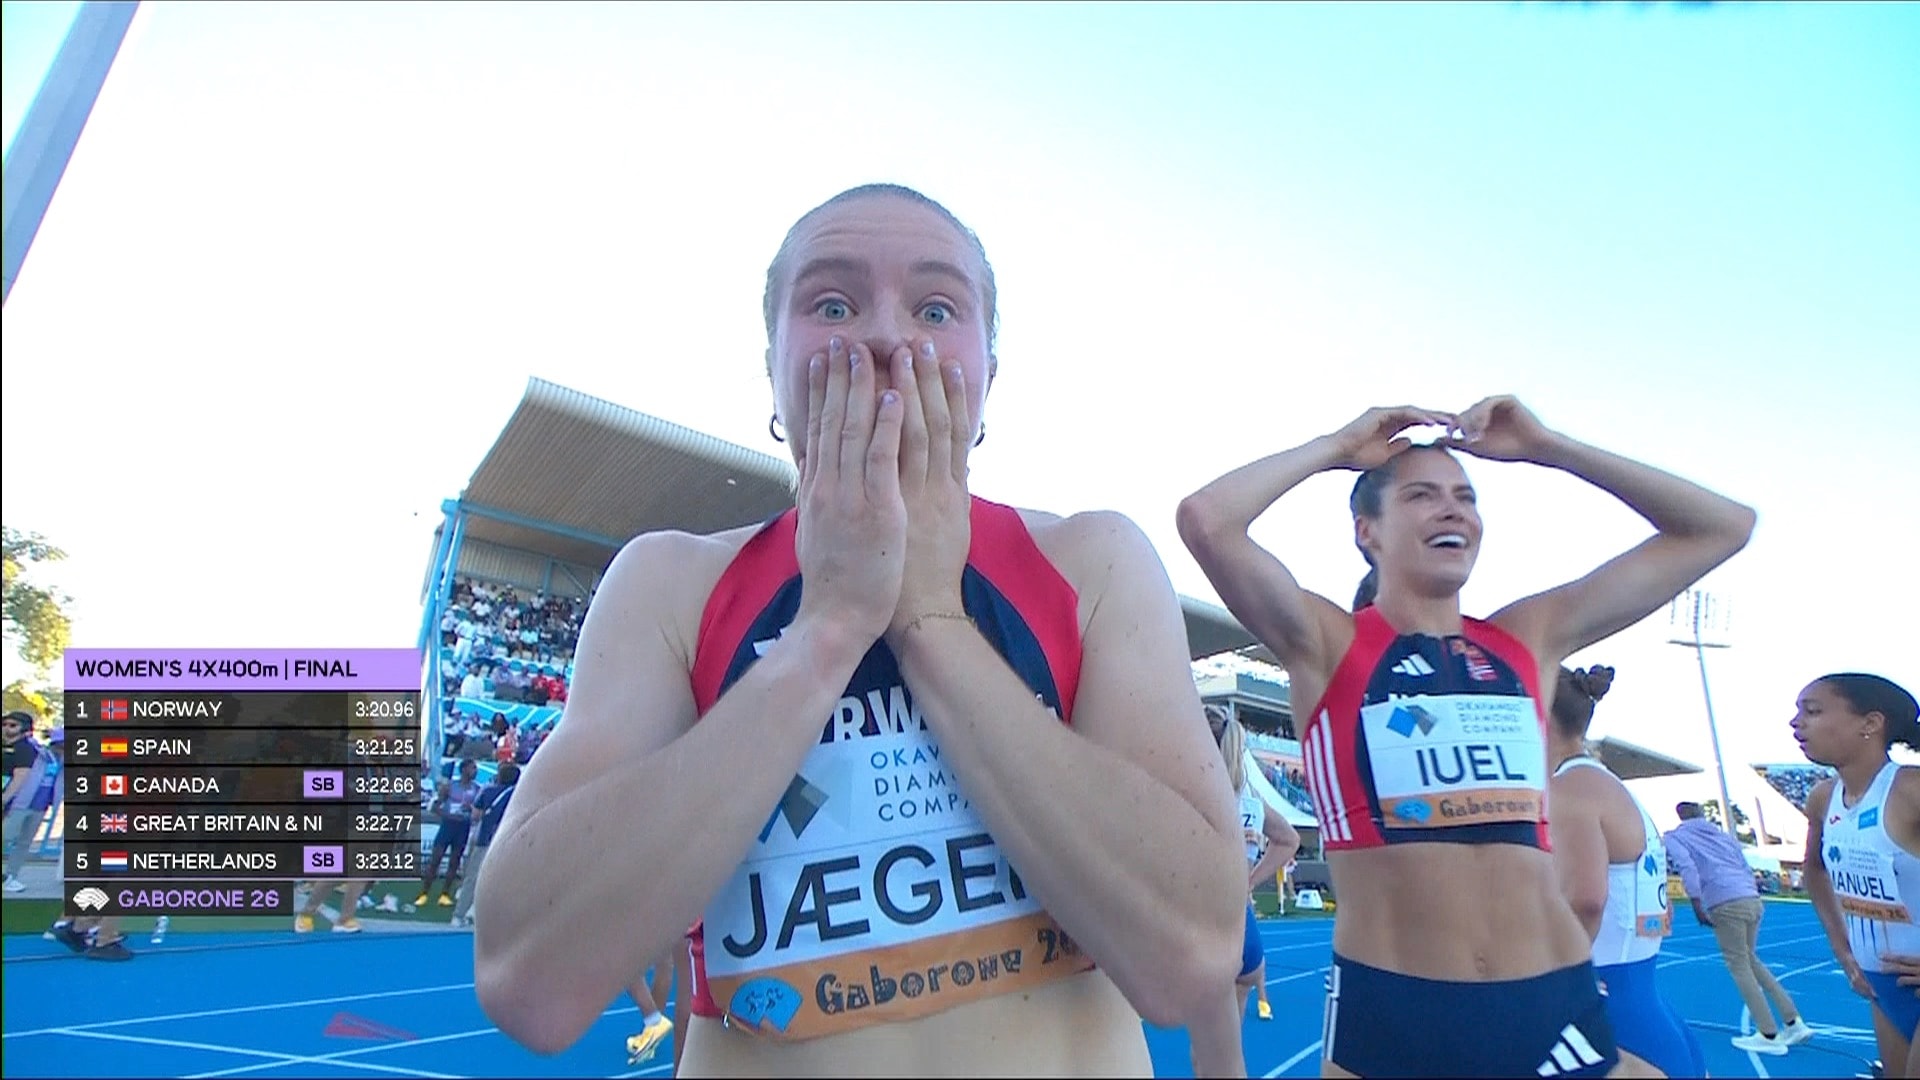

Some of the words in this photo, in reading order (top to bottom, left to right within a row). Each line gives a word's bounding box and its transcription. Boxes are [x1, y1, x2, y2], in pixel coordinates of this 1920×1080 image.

[870, 745, 940, 770] OKAV
[1415, 744, 1528, 787] IUEL
[874, 770, 957, 796] DIAM
[814, 949, 1023, 1016] Gaborone
